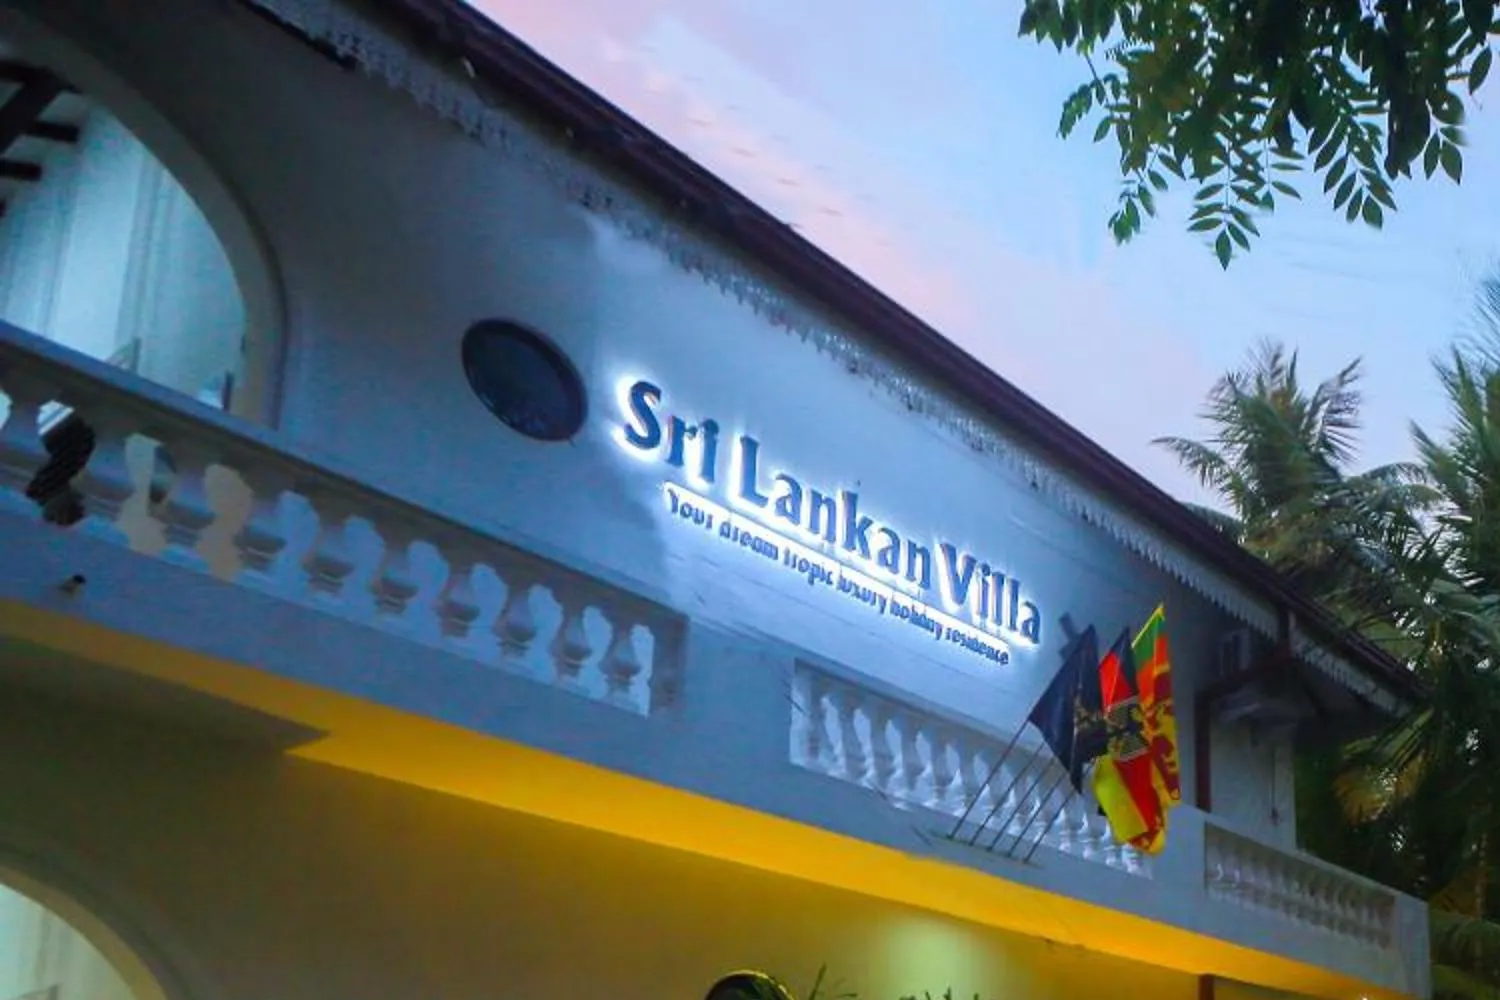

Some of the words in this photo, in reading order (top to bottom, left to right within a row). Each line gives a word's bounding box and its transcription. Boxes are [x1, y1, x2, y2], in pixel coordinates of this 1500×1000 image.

[623, 380, 720, 483] Sri
[738, 434, 931, 590] Lankan
[939, 541, 1042, 645] Villa
